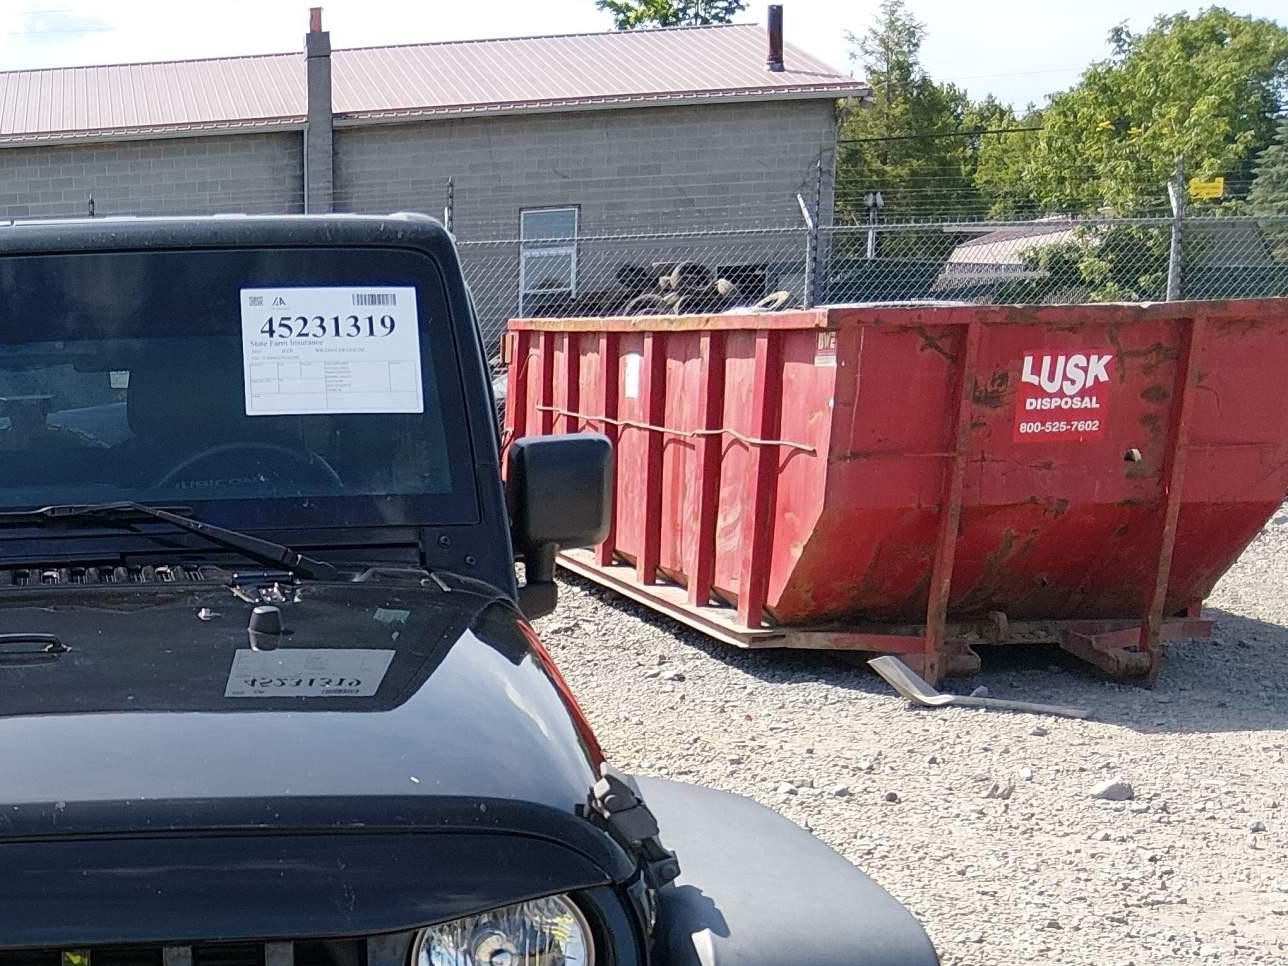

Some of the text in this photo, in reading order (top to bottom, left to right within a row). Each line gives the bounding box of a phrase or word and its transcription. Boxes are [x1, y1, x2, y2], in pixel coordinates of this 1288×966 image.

[260, 315, 395, 338] 45231319
[1021, 354, 1112, 395] LUSK
[1025, 396, 1100, 410] DISPOSAL
[1019, 420, 1100, 433] 800-525-7602
